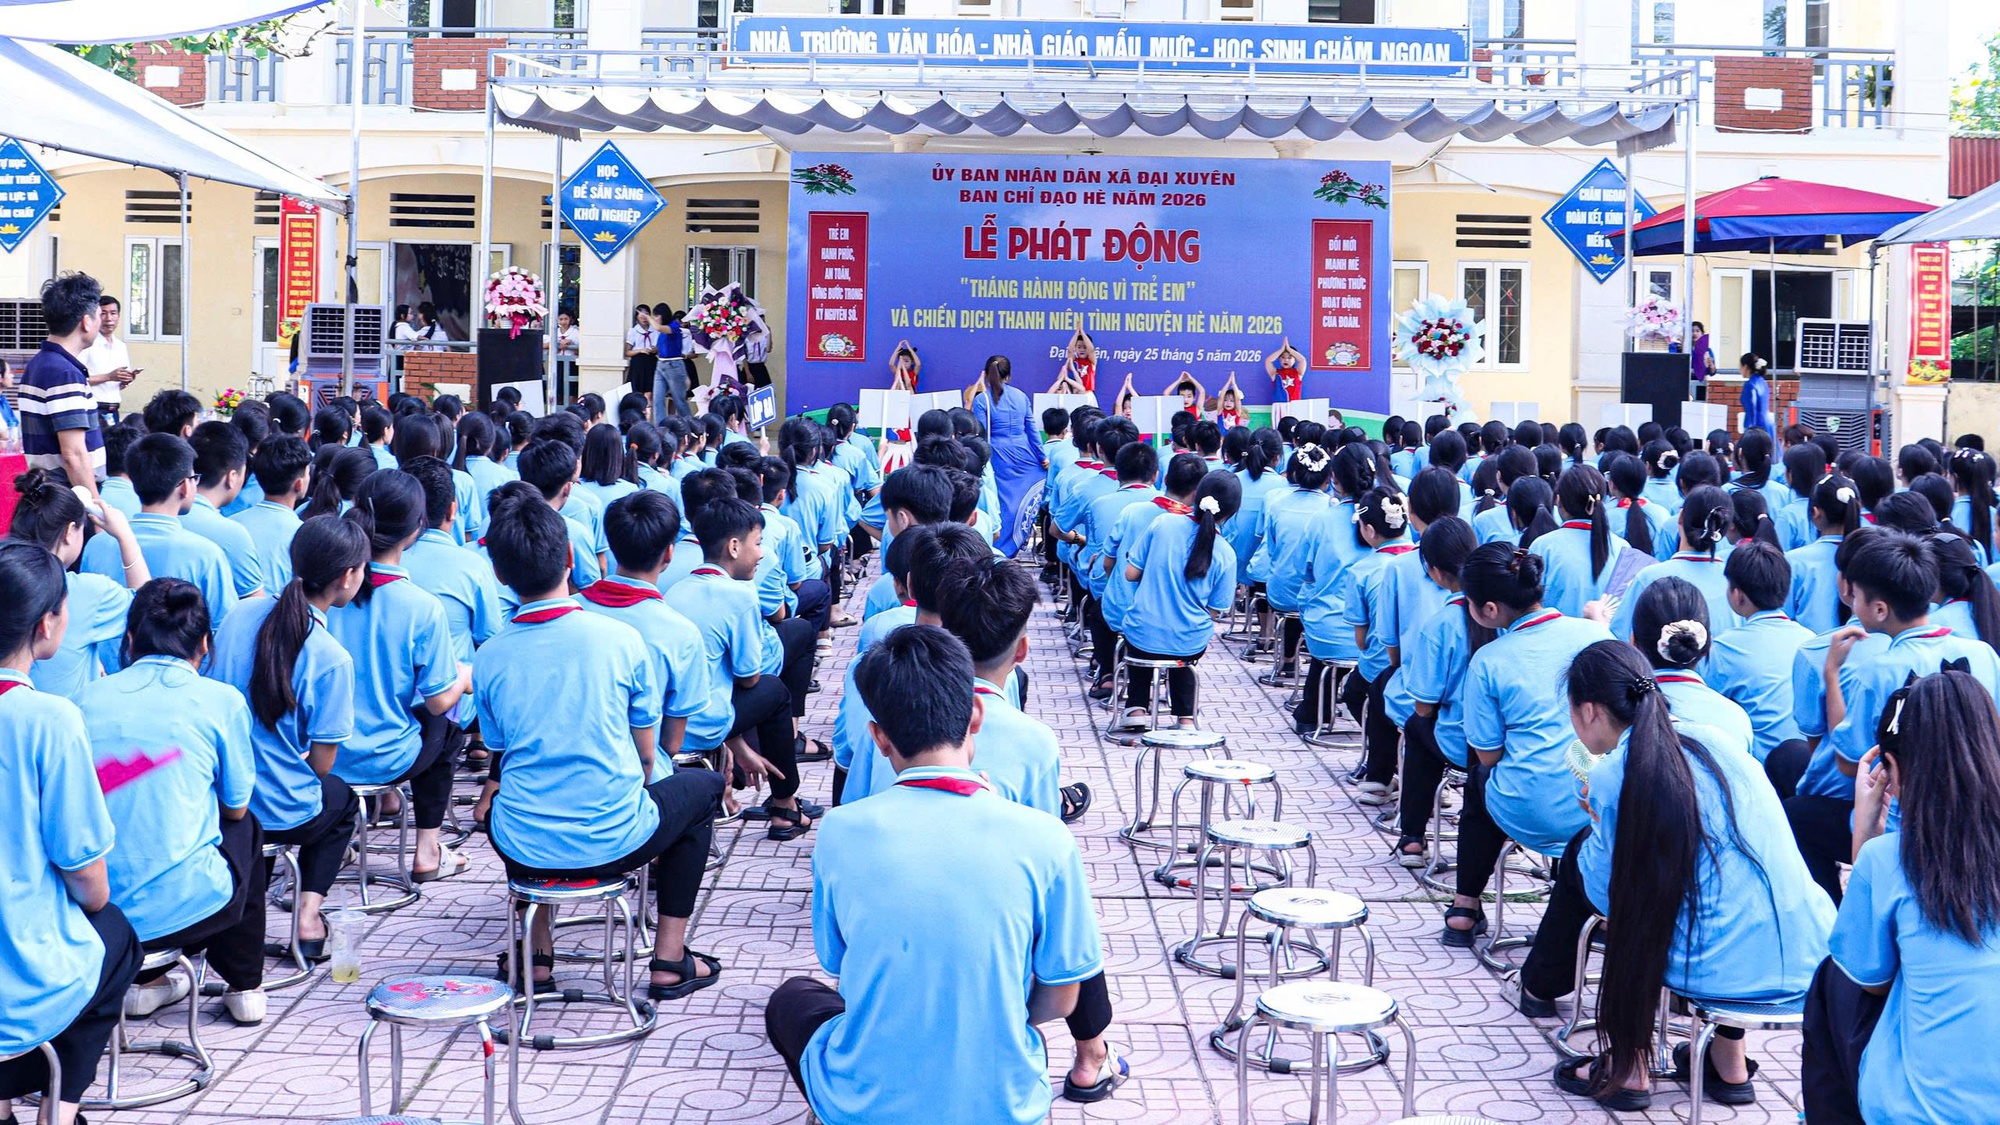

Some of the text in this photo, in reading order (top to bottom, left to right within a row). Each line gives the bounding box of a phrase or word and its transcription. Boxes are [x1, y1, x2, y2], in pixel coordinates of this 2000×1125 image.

[750, 26, 791, 53] NHÀ
[800, 25, 878, 54] TRƯỜNG
[888, 27, 928, 54] VĂN
[936, 28, 974, 56] HÓA
[994, 29, 1034, 56] NHÀ
[1042, 30, 1088, 56] GIÁO
[1095, 27, 1141, 58] MẪU
[1150, 35, 1196, 67] MỰC
[1214, 38, 1254, 68] HỌC
[1260, 38, 1306, 60] SINH
[1314, 36, 1373, 61] CHĂM
[1380, 41, 1450, 62] NGOAN
[596, 164, 619, 180] HỌC
[932, 162, 1236, 188] ỦY BAN NHÂN DÂN XÃ ĐẠI XUYÊN
[573, 181, 644, 200] ĐỂ SẴN SÀNG
[960, 186, 1206, 206] BAN CHỈ ĐẠO HÈ NĂM 2026
[574, 204, 641, 225] KHỞI NGHIỆP
[1566, 209, 1587, 224] ĐOÀN
[840, 228, 850, 240] EM
[963, 214, 1200, 271] LỄ PHÁT ĐỘNG
[825, 268, 833, 280] AN
[1023, 276, 1062, 300] HÀNH
[1068, 278, 1108, 304] ĐỘNG
[1112, 278, 1127, 300] VÌ
[1132, 274, 1157, 300] TRẺ
[891, 302, 1282, 336] VÀ CHIẾN DỊCH THANH NIÊN TÌNH NGUYỆN HÈ NĂM 2026
[1113, 348, 1142, 363] ngày
[1144, 348, 1159, 360] 25
[1160, 348, 1194, 364] tháng
[1196, 349, 1204, 361] 5
[1206, 350, 1232, 362] năm
[1234, 350, 1262, 362] 2026
